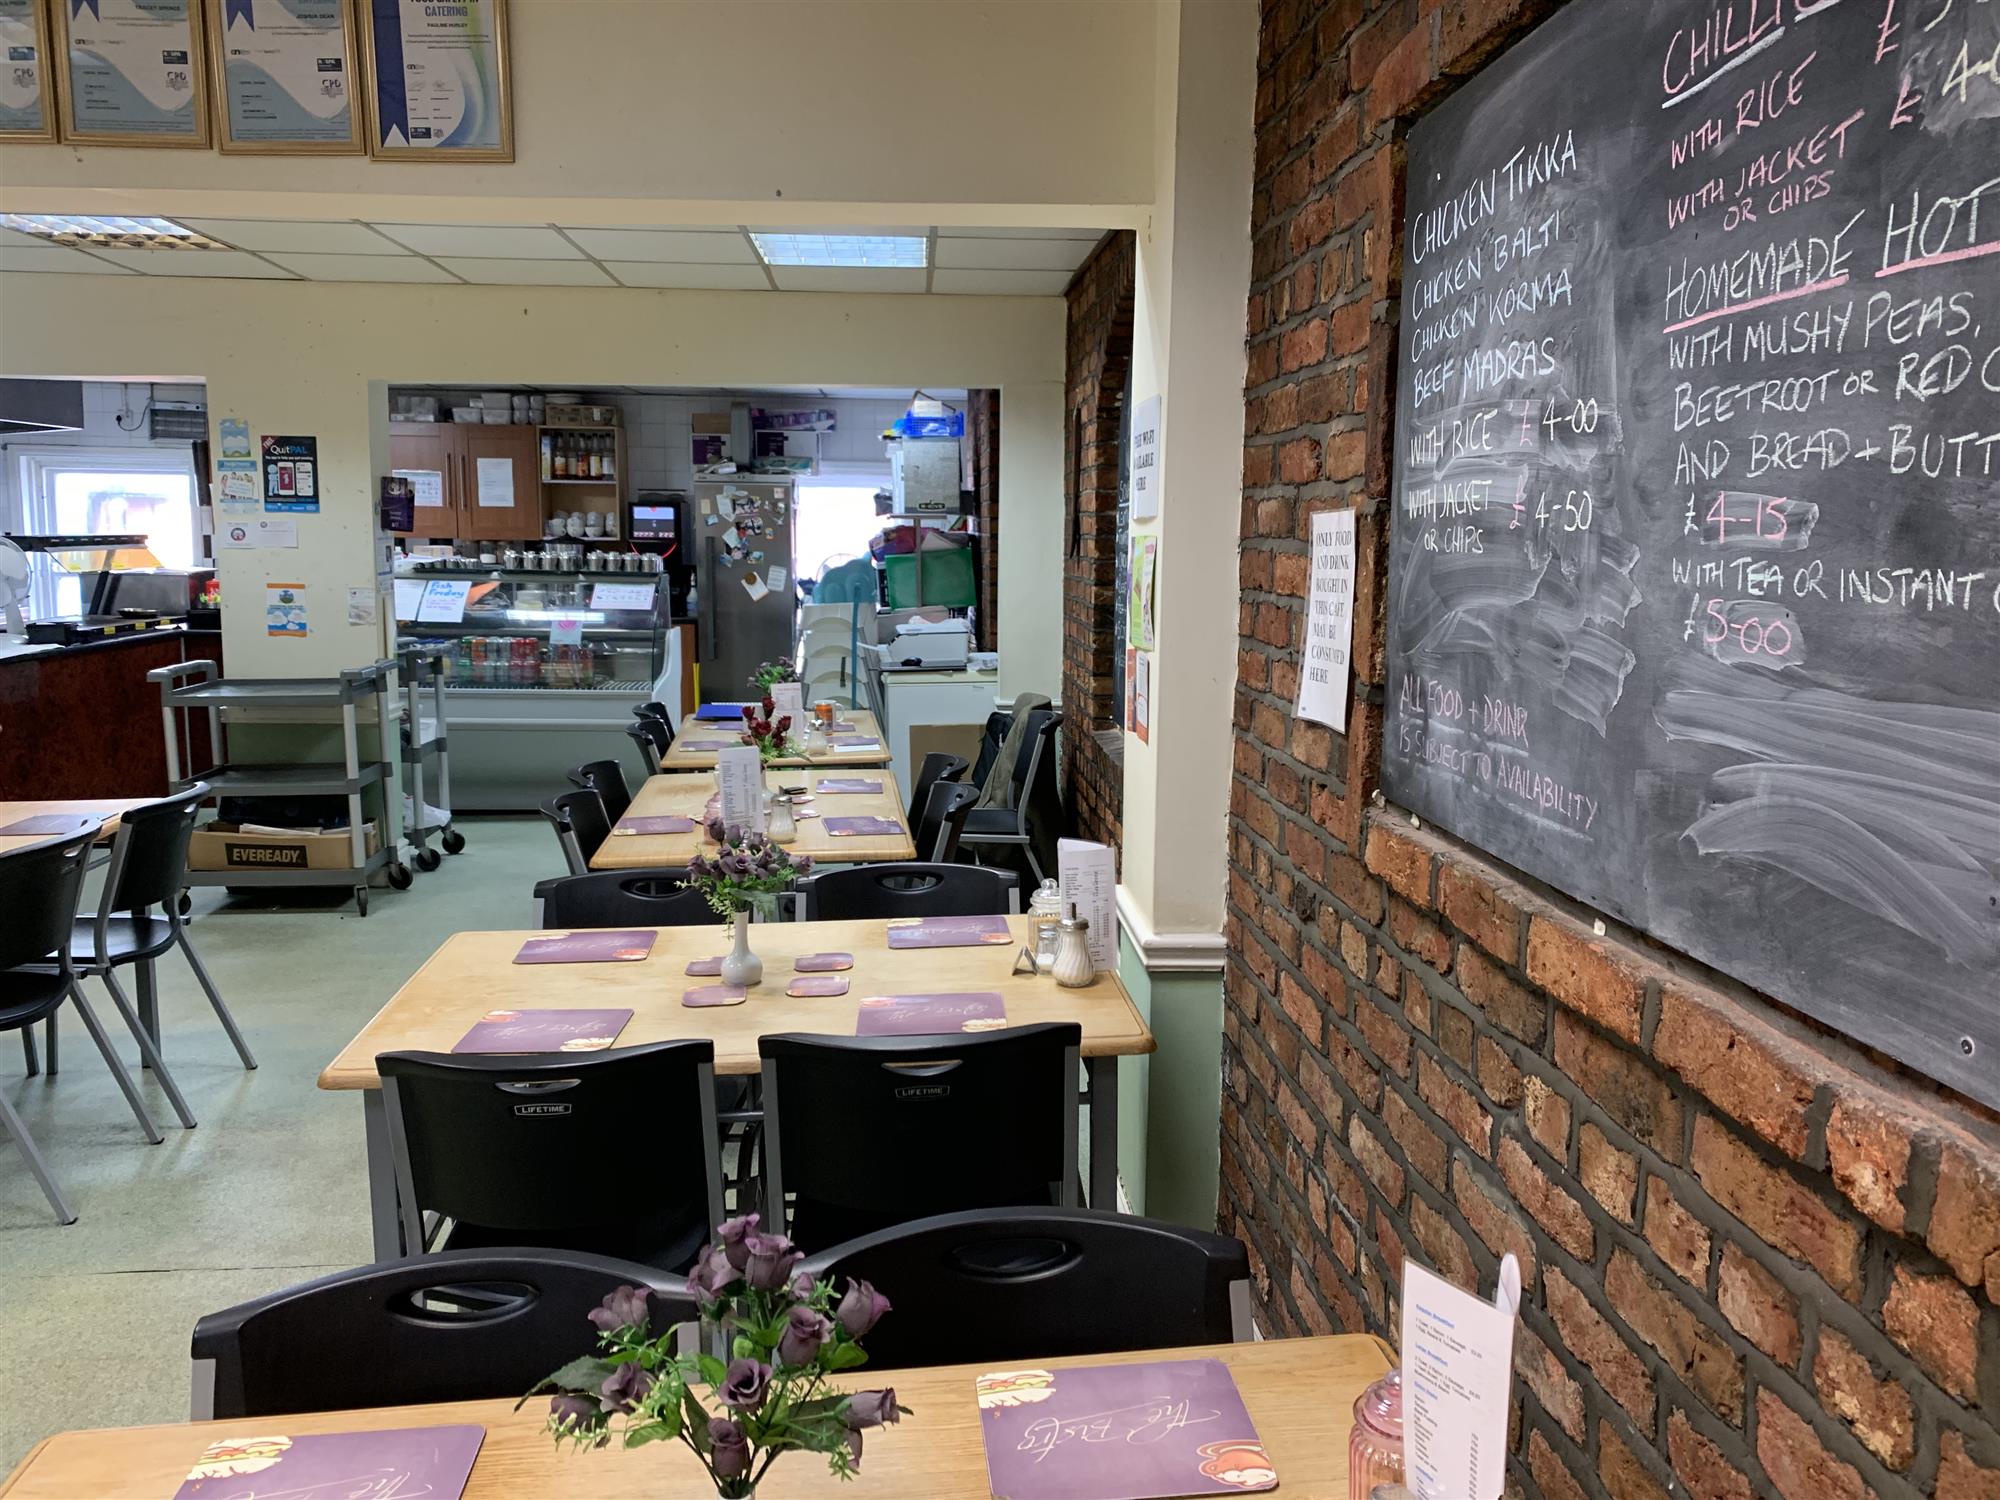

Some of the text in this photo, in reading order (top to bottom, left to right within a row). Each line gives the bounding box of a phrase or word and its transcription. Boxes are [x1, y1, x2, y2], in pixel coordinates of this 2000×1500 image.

[425, 6, 468, 17] CATERING
[1671, 118, 1723, 170] WITH
[1736, 51, 1818, 134] RICE
[1668, 178, 1725, 230] WITH
[1734, 107, 1866, 199] JACKET
[1412, 129, 1578, 264] CHICKEN TIKKA
[1724, 169, 1836, 232] OR CHIPS
[1412, 208, 1560, 321] CHICKEN BALTI
[1665, 176, 2000, 320] HOMEMADE HOT
[1411, 267, 1573, 363] CHICKEN KORMA
[1669, 290, 1982, 370] WITH MUSHY PEAS,
[1414, 337, 1556, 409] BEEF MADRAS
[1673, 368, 1841, 433] BEETROOT
[1842, 369, 1880, 396] OR
[1896, 343, 1973, 403] RED
[270, 444, 308, 455] QuitPAL
[1410, 419, 1444, 468] WITH
[1451, 408, 1499, 457] RICE
[1674, 439, 1731, 486] AND
[1747, 427, 1851, 478] BREAD
[1854, 438, 1882, 461] +
[1408, 483, 1438, 523] WITH
[1439, 479, 1493, 519] JACKET
[1535, 489, 1594, 532] 4-50
[1706, 490, 1788, 544] 4-15
[1315, 529, 1353, 550] ONLY FOOD
[1316, 552, 1350, 572] AND DRINK
[1424, 525, 1485, 554] OR CHIPS
[1314, 599, 1328, 617] THIS
[1315, 577, 1349, 595] BOUGHT IN
[1673, 557, 1725, 588] WITH
[1729, 556, 1784, 596] TEA
[1793, 560, 1828, 600] OR
[1839, 566, 1986, 612] INSTANT
[1312, 622, 1337, 641] MAY BE
[1706, 598, 1792, 656] 5-00
[1309, 666, 1330, 685] HERE
[1310, 644, 1346, 666] CONSUMED
[1400, 672, 1425, 714] ALL
[1427, 679, 1463, 721] FOOD
[1468, 699, 1479, 725] +
[1398, 723, 1598, 831] IS SUBJECT TO AVAILABILITY
[232, 848, 300, 863] EVEREADY
[521, 1105, 565, 1113] LIFETIME
[902, 1087, 943, 1097] LIFETIME
[1126, 1397, 1222, 1446] The
